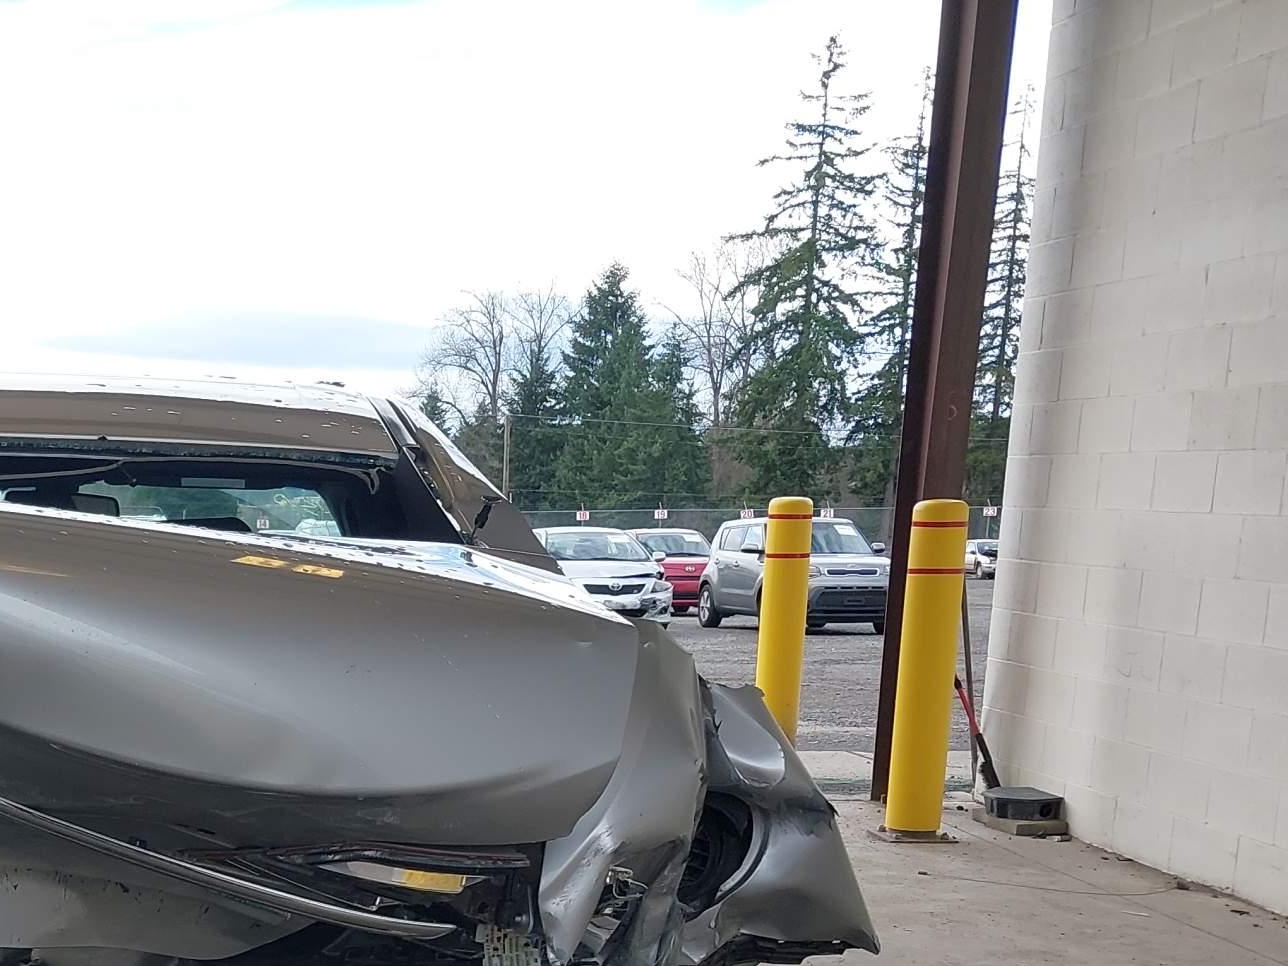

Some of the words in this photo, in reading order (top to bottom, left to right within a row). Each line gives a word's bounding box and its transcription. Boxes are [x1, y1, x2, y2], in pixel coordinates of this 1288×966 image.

[656, 511, 666, 519] 19
[742, 510, 752, 518] 20
[823, 509, 832, 518] 21
[985, 508, 996, 516] 23
